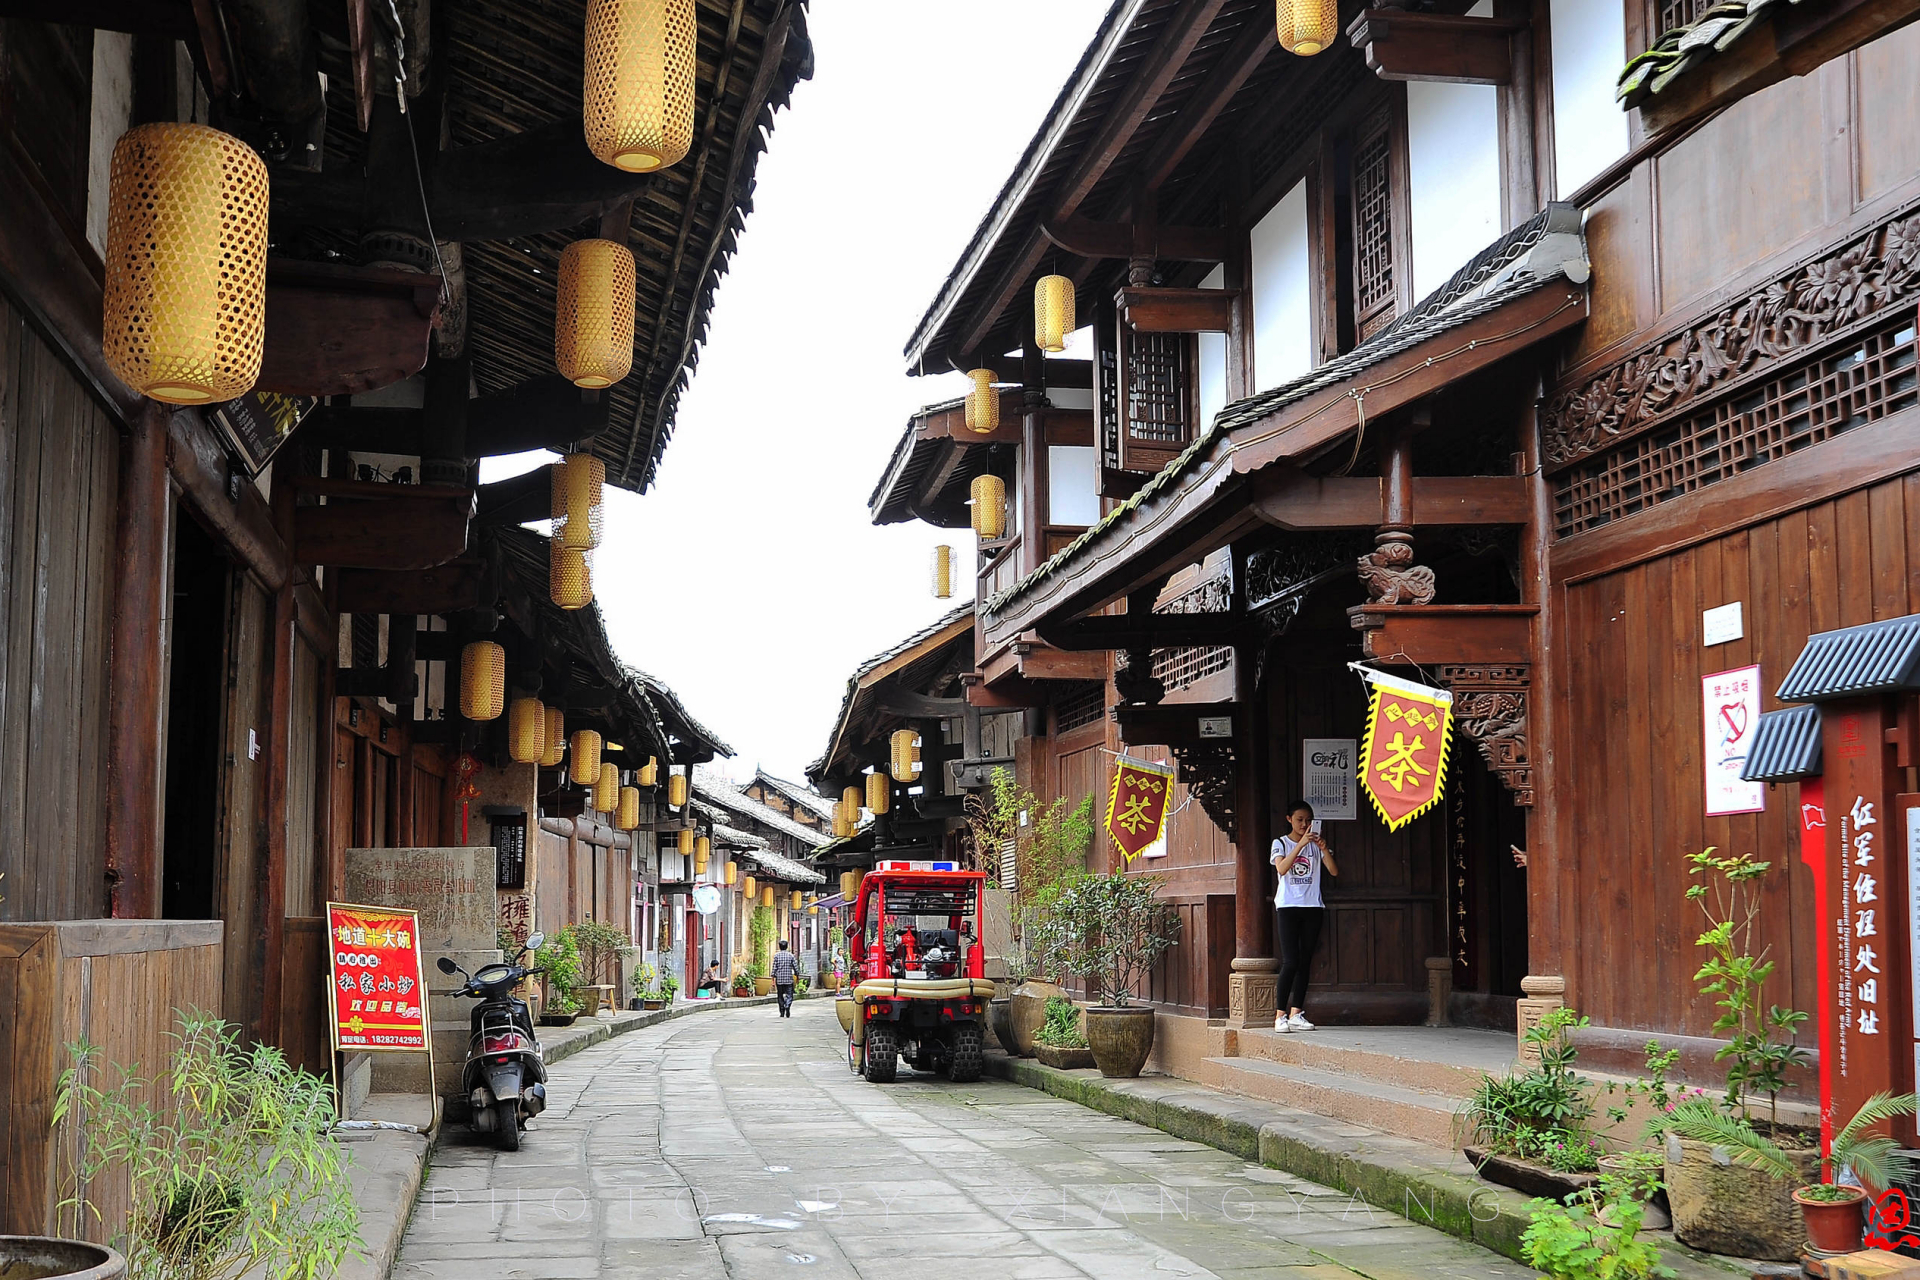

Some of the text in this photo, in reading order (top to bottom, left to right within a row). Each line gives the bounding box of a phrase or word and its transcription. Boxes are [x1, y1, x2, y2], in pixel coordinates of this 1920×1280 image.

[1375, 731, 1431, 793] 茶
[1116, 794, 1155, 836] 茶
[337, 925, 412, 949] 地道十大碗
[338, 972, 415, 996] 私家小炒
[349, 999, 409, 1014] 欢迎品尝
[371, 1035, 422, 1045] 18282742992
